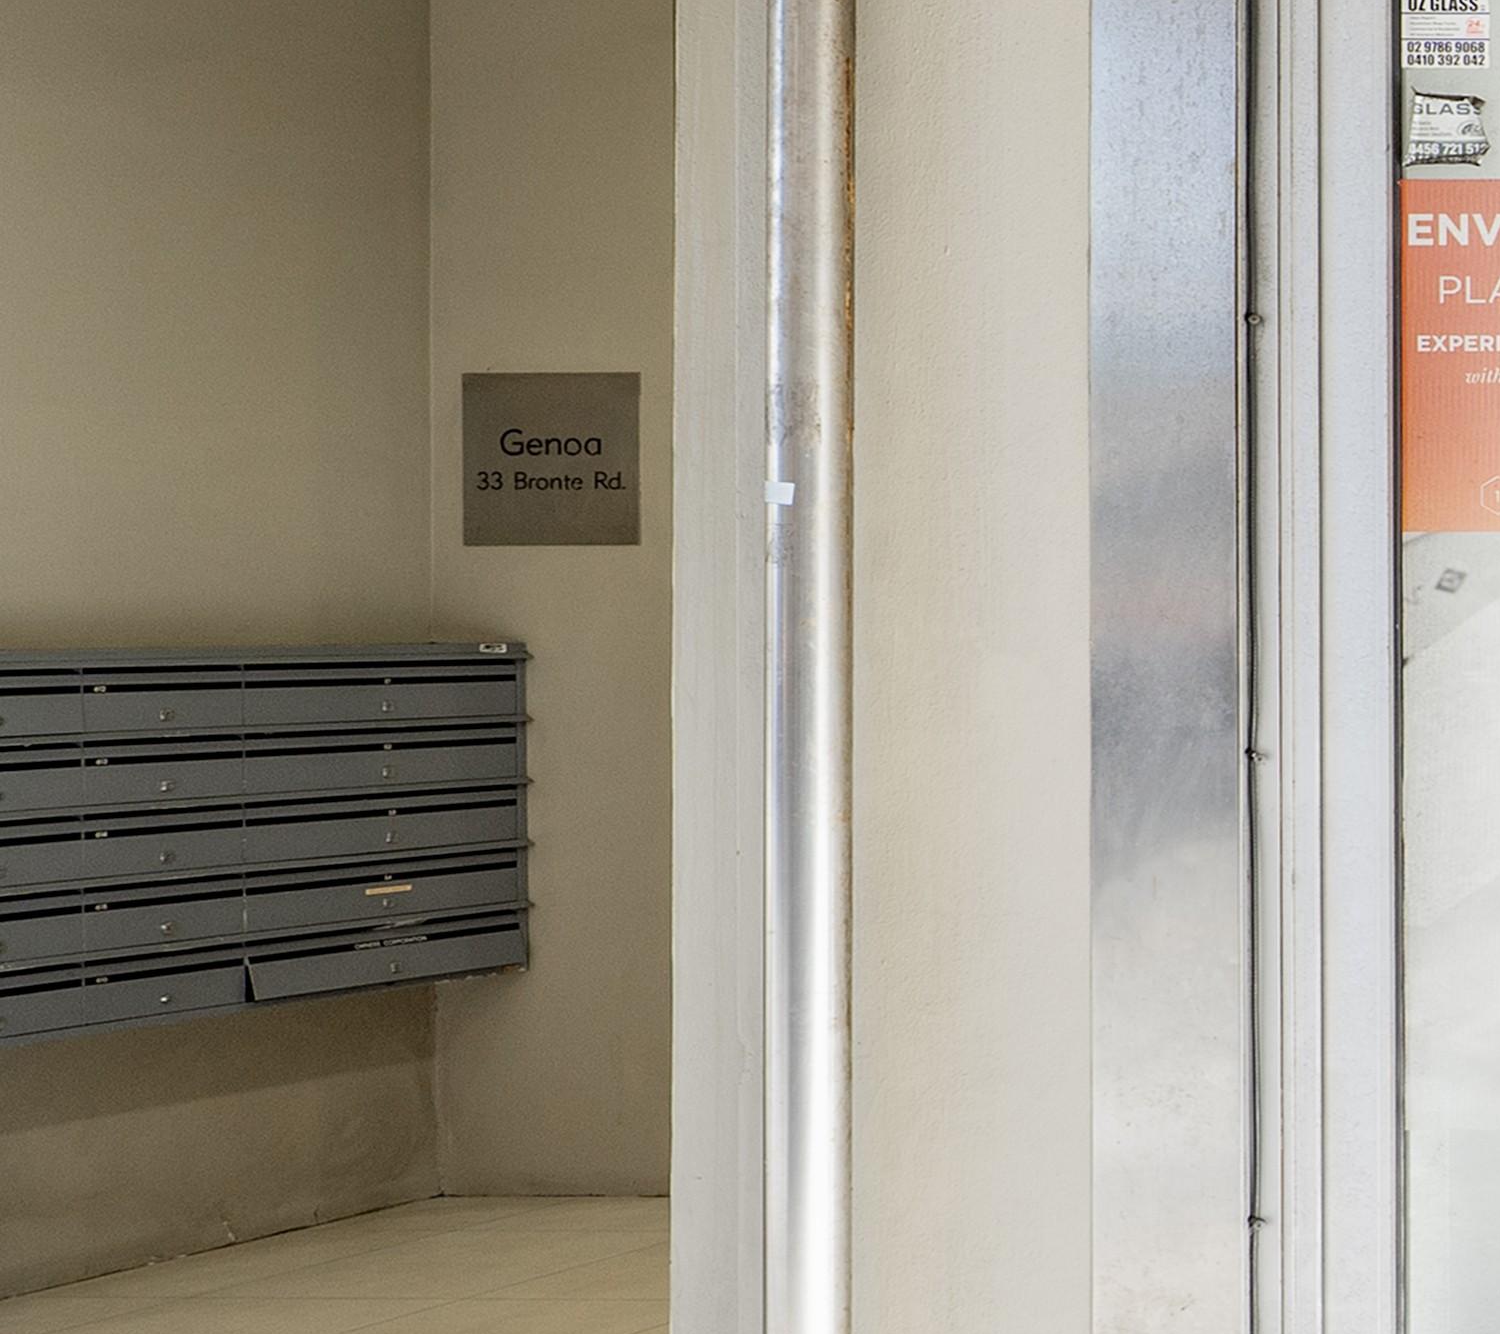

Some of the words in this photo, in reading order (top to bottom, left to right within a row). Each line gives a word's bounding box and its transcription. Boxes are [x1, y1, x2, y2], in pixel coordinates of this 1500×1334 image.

[1407, 41, 1421, 53] 02
[1425, 41, 1452, 53] 9786
[1455, 41, 1485, 53] 9068
[1407, 54, 1435, 66] 0410
[1438, 54, 1460, 66] 392
[1463, 54, 1485, 66] 042
[500, 429, 603, 456] Genoa
[477, 471, 503, 490] 33
[514, 471, 583, 490] Bronte
[594, 471, 626, 490] Rd.
